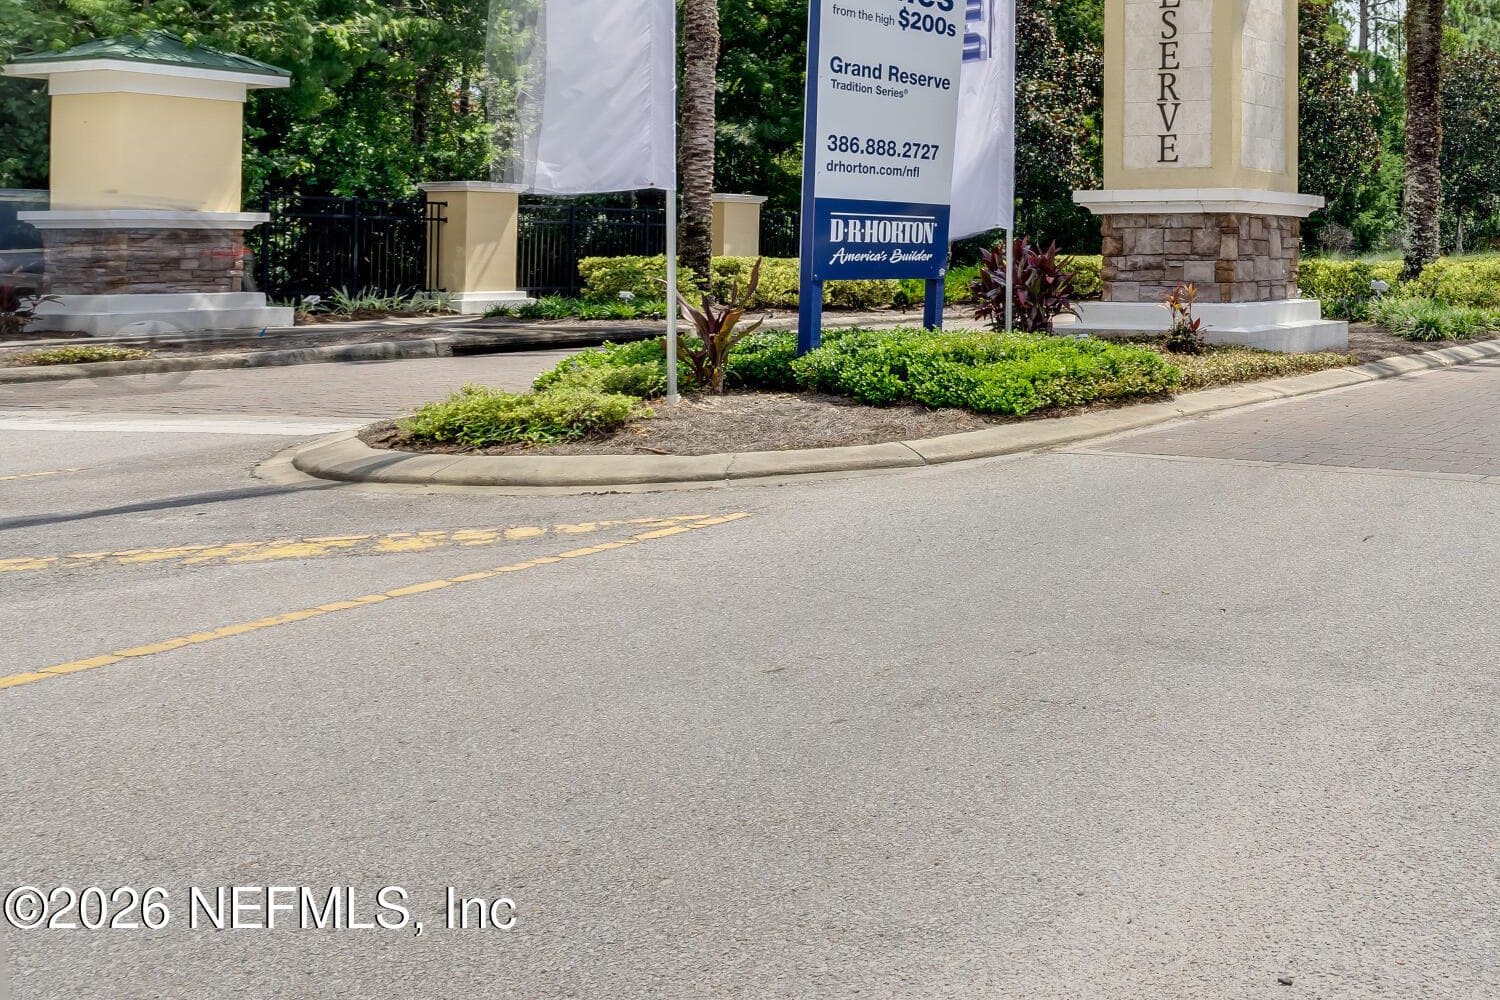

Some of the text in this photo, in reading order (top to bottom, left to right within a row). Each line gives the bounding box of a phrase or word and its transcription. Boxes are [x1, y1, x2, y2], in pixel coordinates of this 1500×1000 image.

[832, 4, 956, 37] from the high $200s
[830, 56, 951, 90] Grand Reserve
[830, 79, 873, 94] Tradition
[827, 134, 939, 160] 386.888.2727
[826, 160, 920, 178] drhorton.com/nfl
[828, 247, 933, 265] America's Builder
